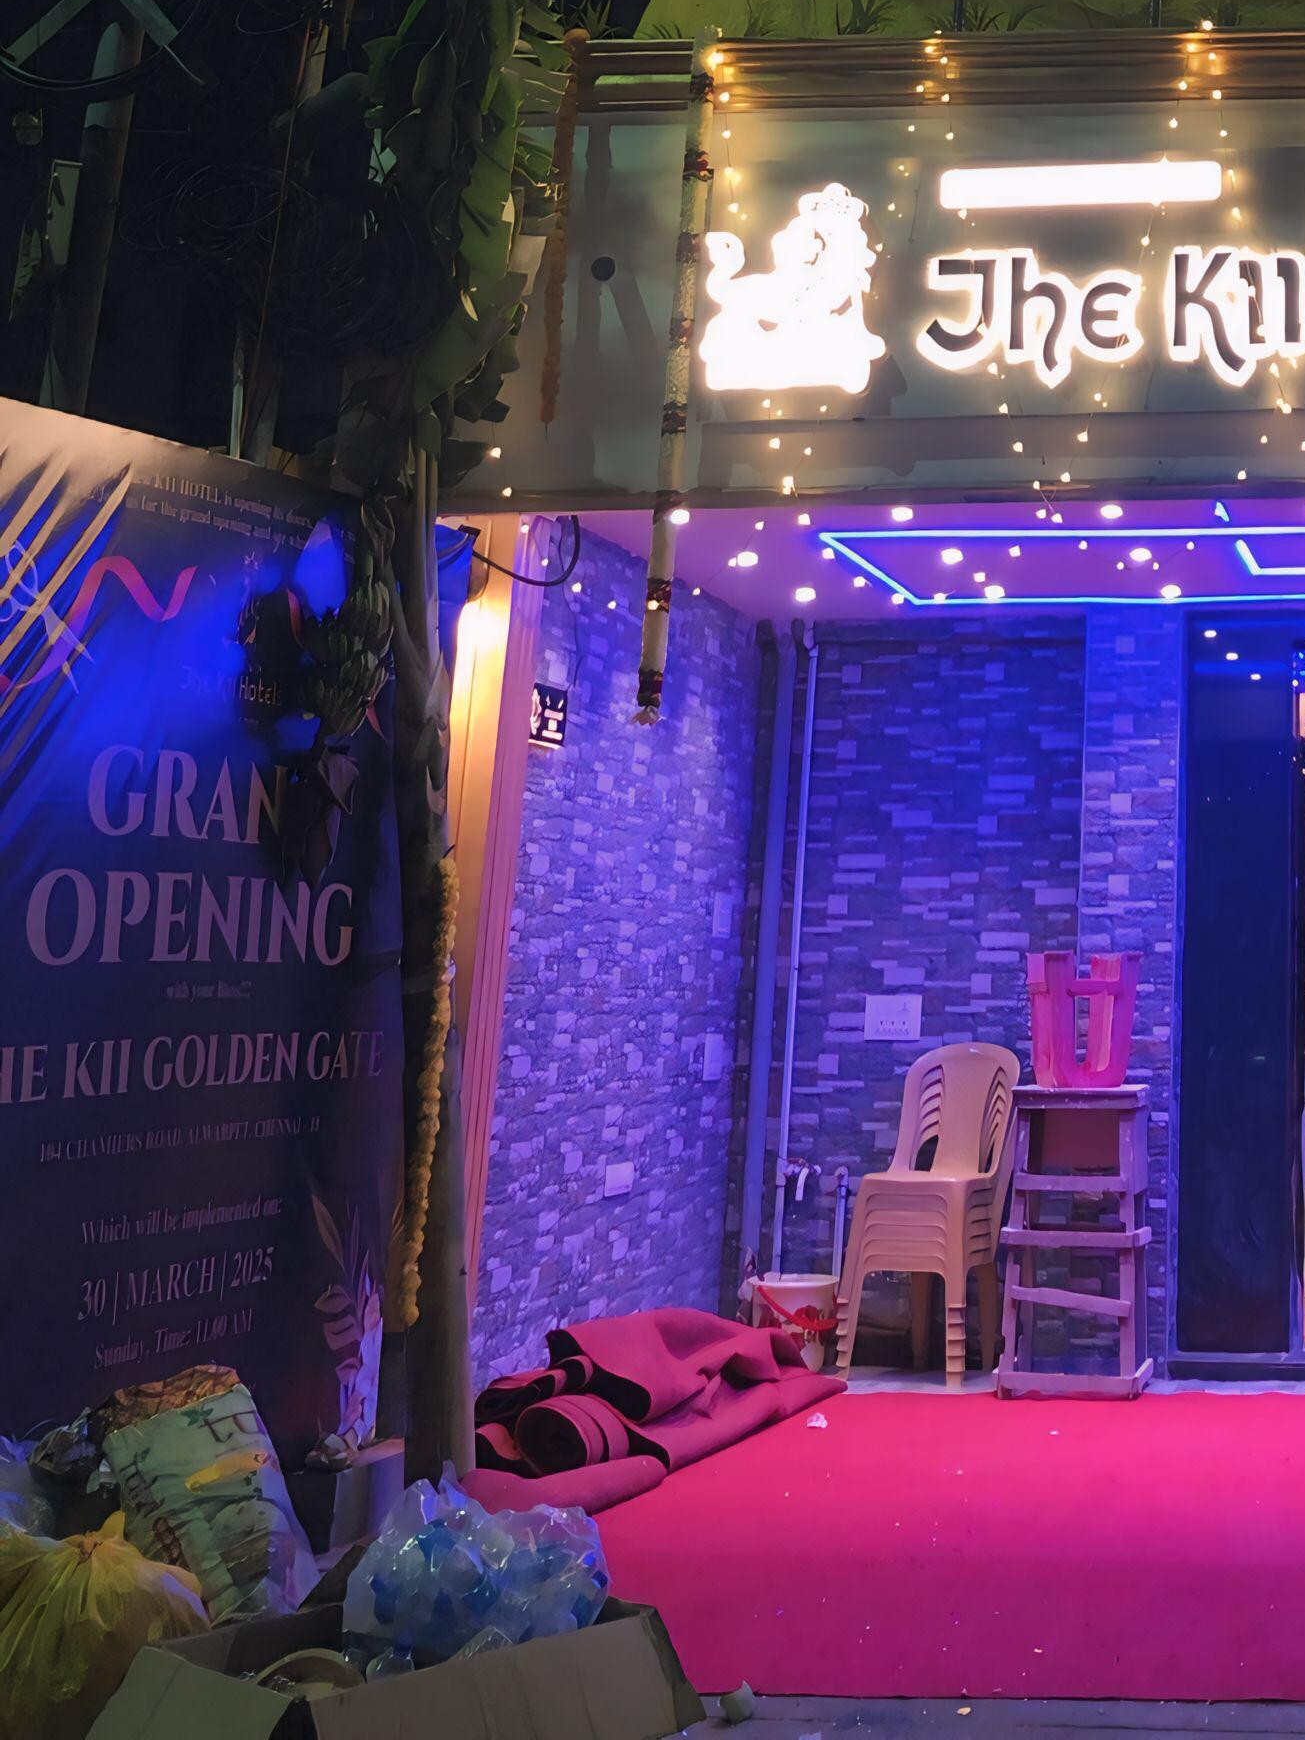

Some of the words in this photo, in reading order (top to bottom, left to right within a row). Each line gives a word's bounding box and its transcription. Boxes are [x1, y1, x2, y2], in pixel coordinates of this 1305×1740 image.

[926, 256, 1132, 372] The
[89, 744, 290, 844] GRAN
[26, 868, 354, 966] OPENING
[143, 1032, 300, 1092] GOLDEN
[307, 1031, 384, 1081] GATE
[82, 1214, 131, 1244] Which
[77, 1277, 106, 1321] 30
[126, 1256, 216, 1311] MARCH
[230, 1246, 275, 1288] 2025
